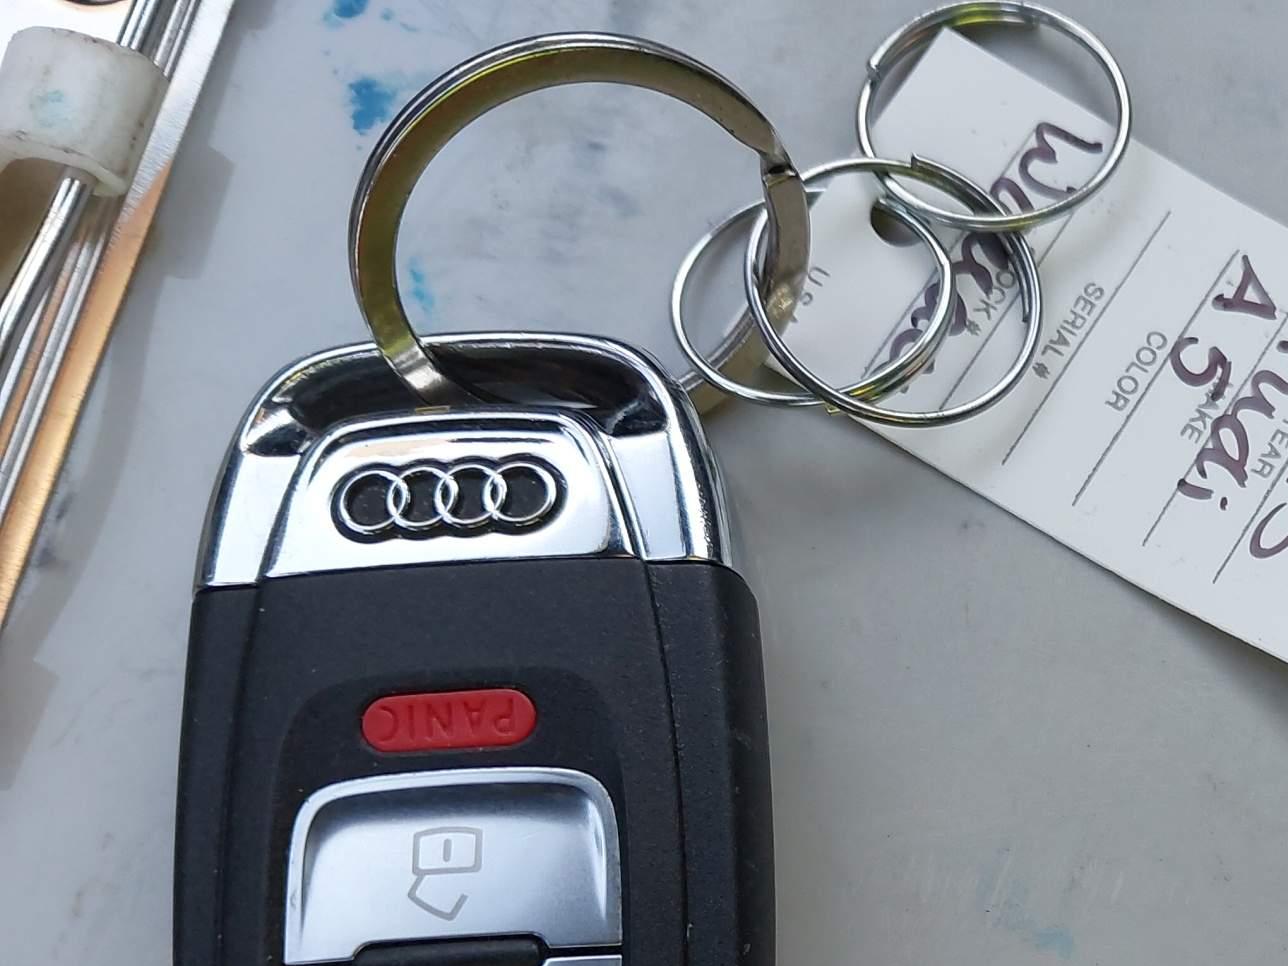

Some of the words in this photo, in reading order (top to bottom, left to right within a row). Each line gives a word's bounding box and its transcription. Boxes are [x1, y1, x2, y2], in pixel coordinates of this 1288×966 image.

[1041, 281, 1106, 359] SERIAL
[1032, 361, 1051, 380] #
[1104, 331, 1169, 413] COLOR
[379, 696, 516, 743] PANIC
